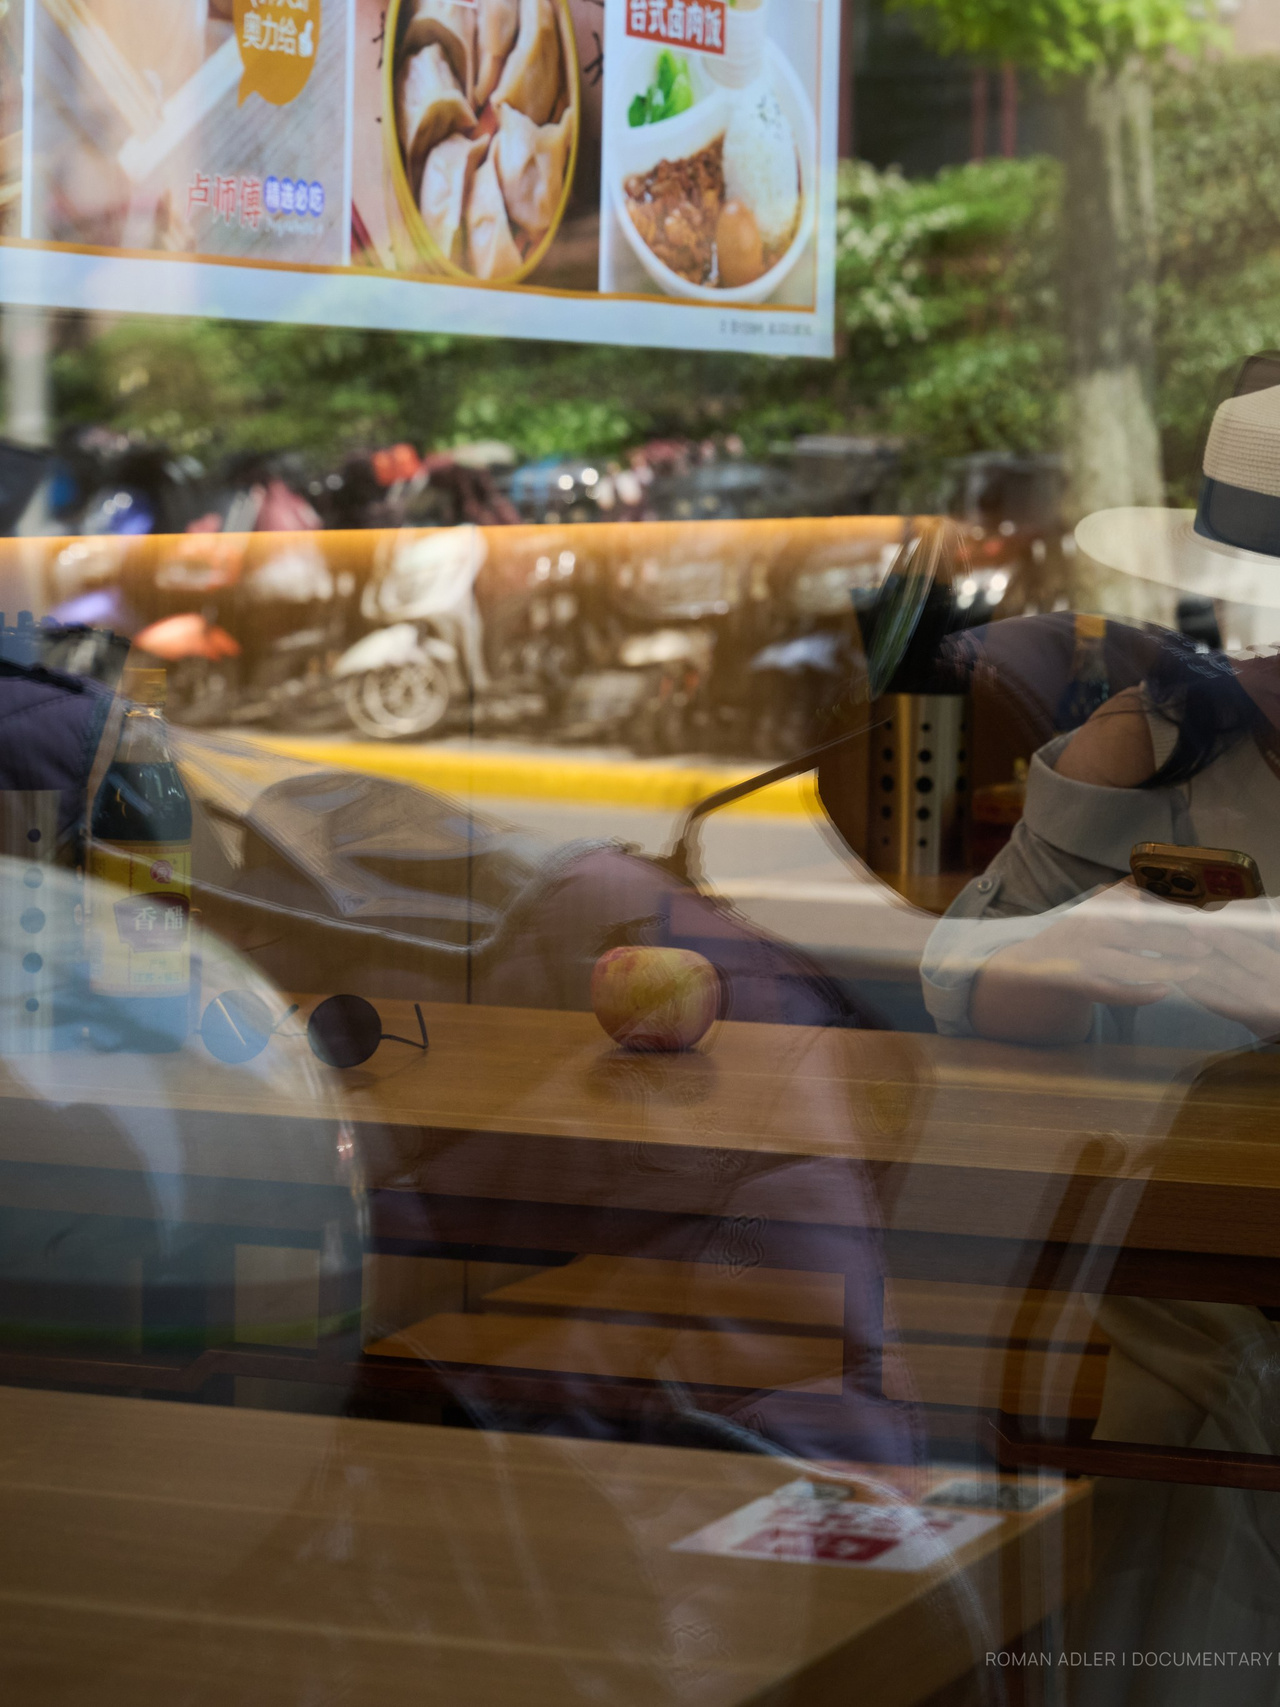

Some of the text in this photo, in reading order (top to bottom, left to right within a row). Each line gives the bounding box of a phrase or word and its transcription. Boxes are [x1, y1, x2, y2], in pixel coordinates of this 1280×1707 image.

[242, 11, 297, 55] 奥力给
[630, 0, 722, 48] 台式卤肉饭
[186, 172, 262, 230] 卢师傅
[132, 905, 183, 931] 香醋
